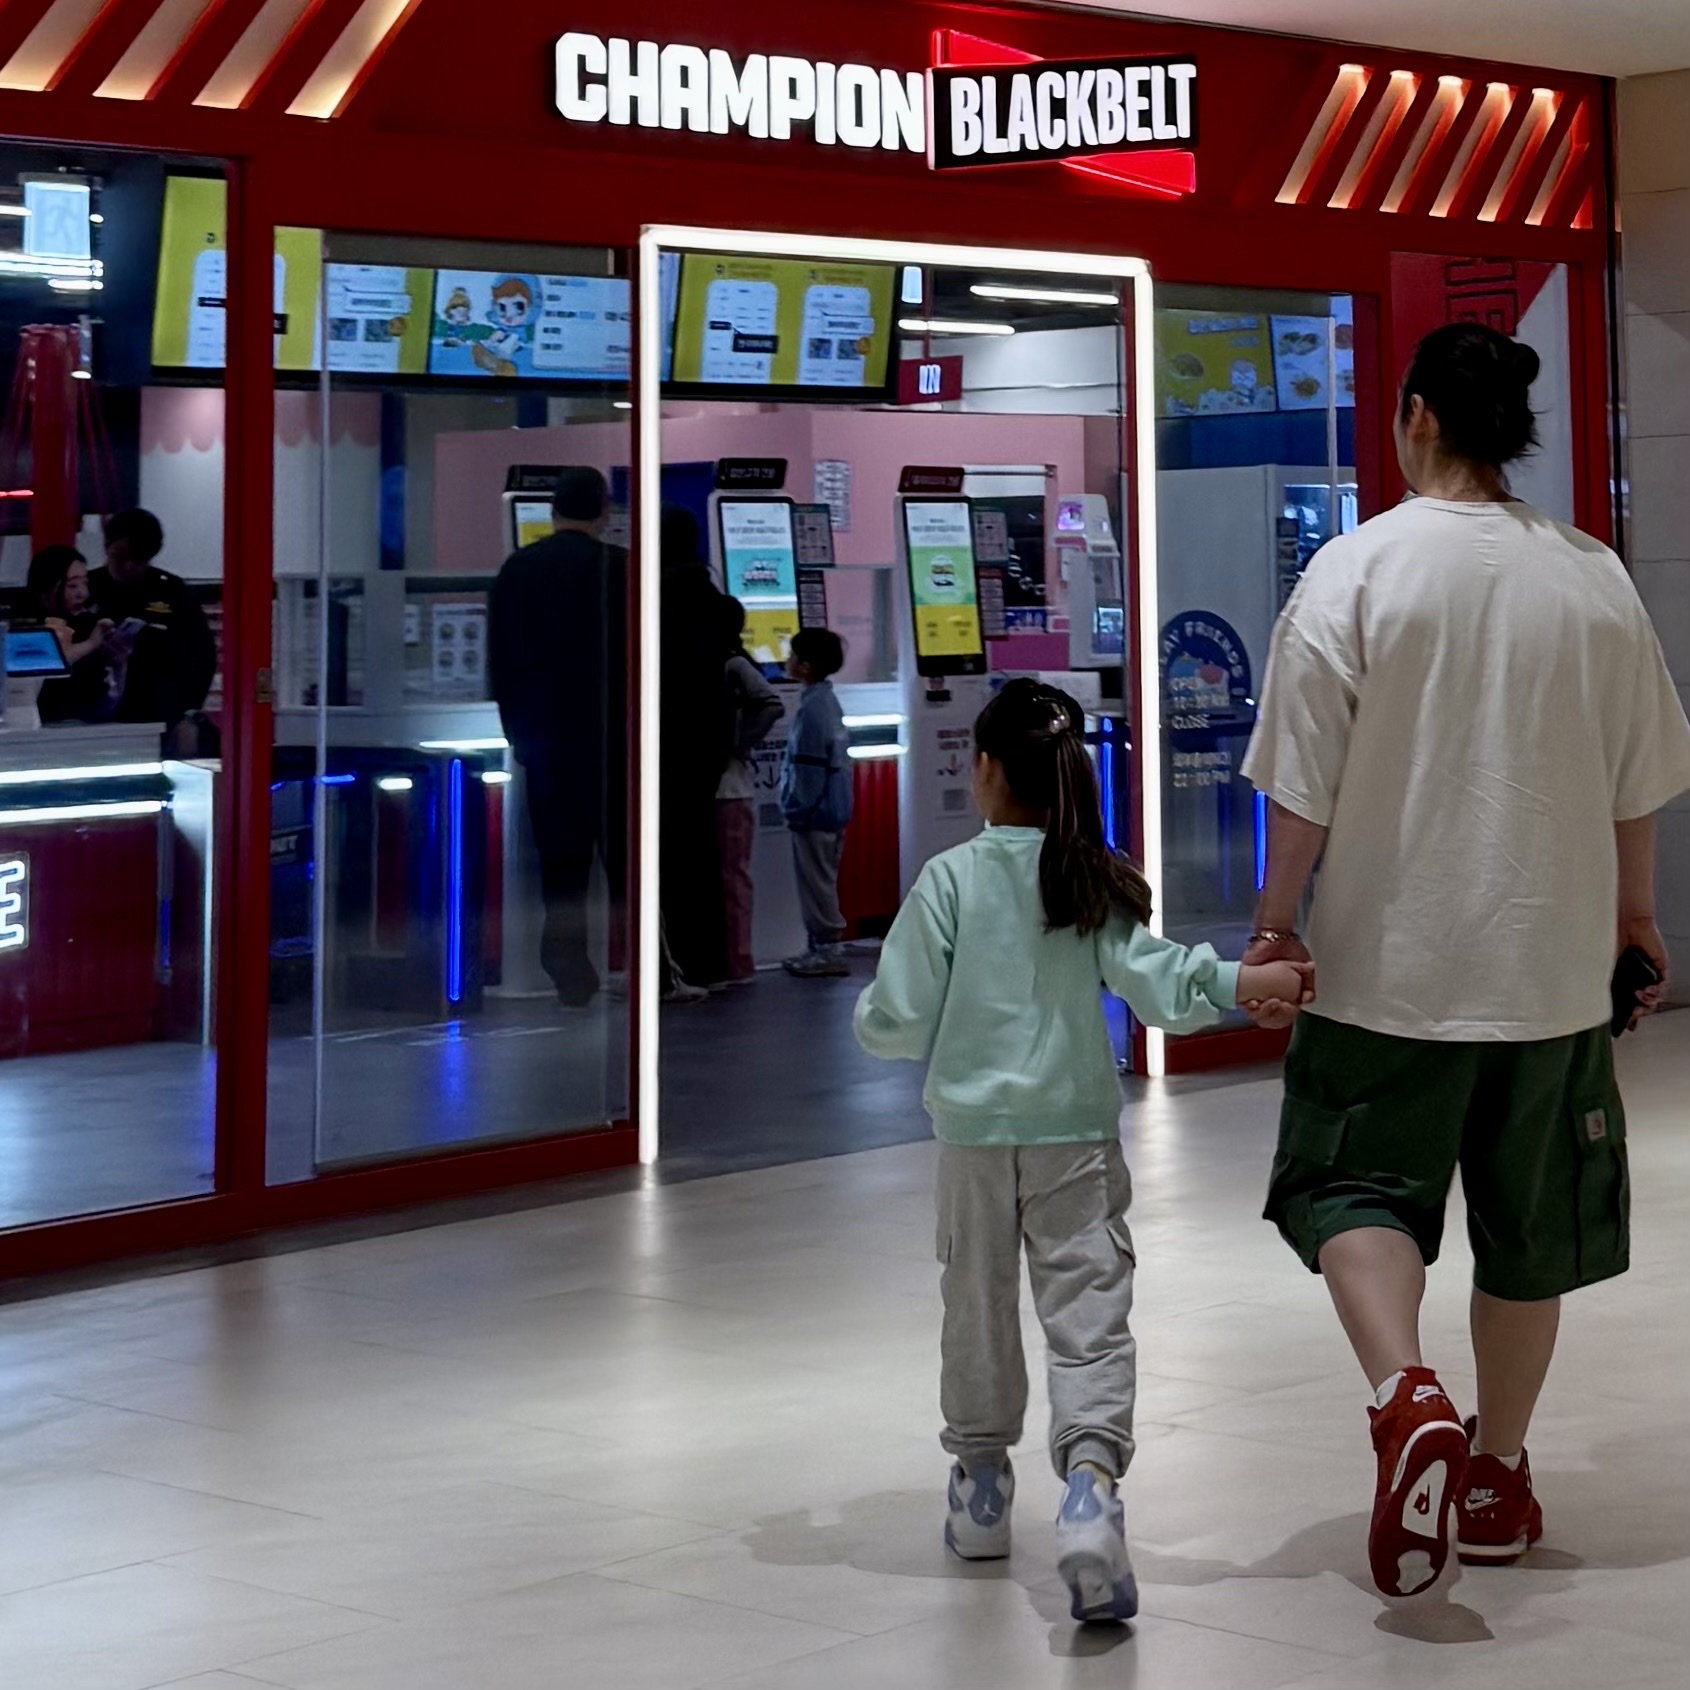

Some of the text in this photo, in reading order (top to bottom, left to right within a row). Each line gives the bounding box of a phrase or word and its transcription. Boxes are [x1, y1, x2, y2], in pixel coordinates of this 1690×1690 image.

[555, 32, 1197, 156] CHAMPION BLACKBELT
[919, 364, 941, 394] IN
